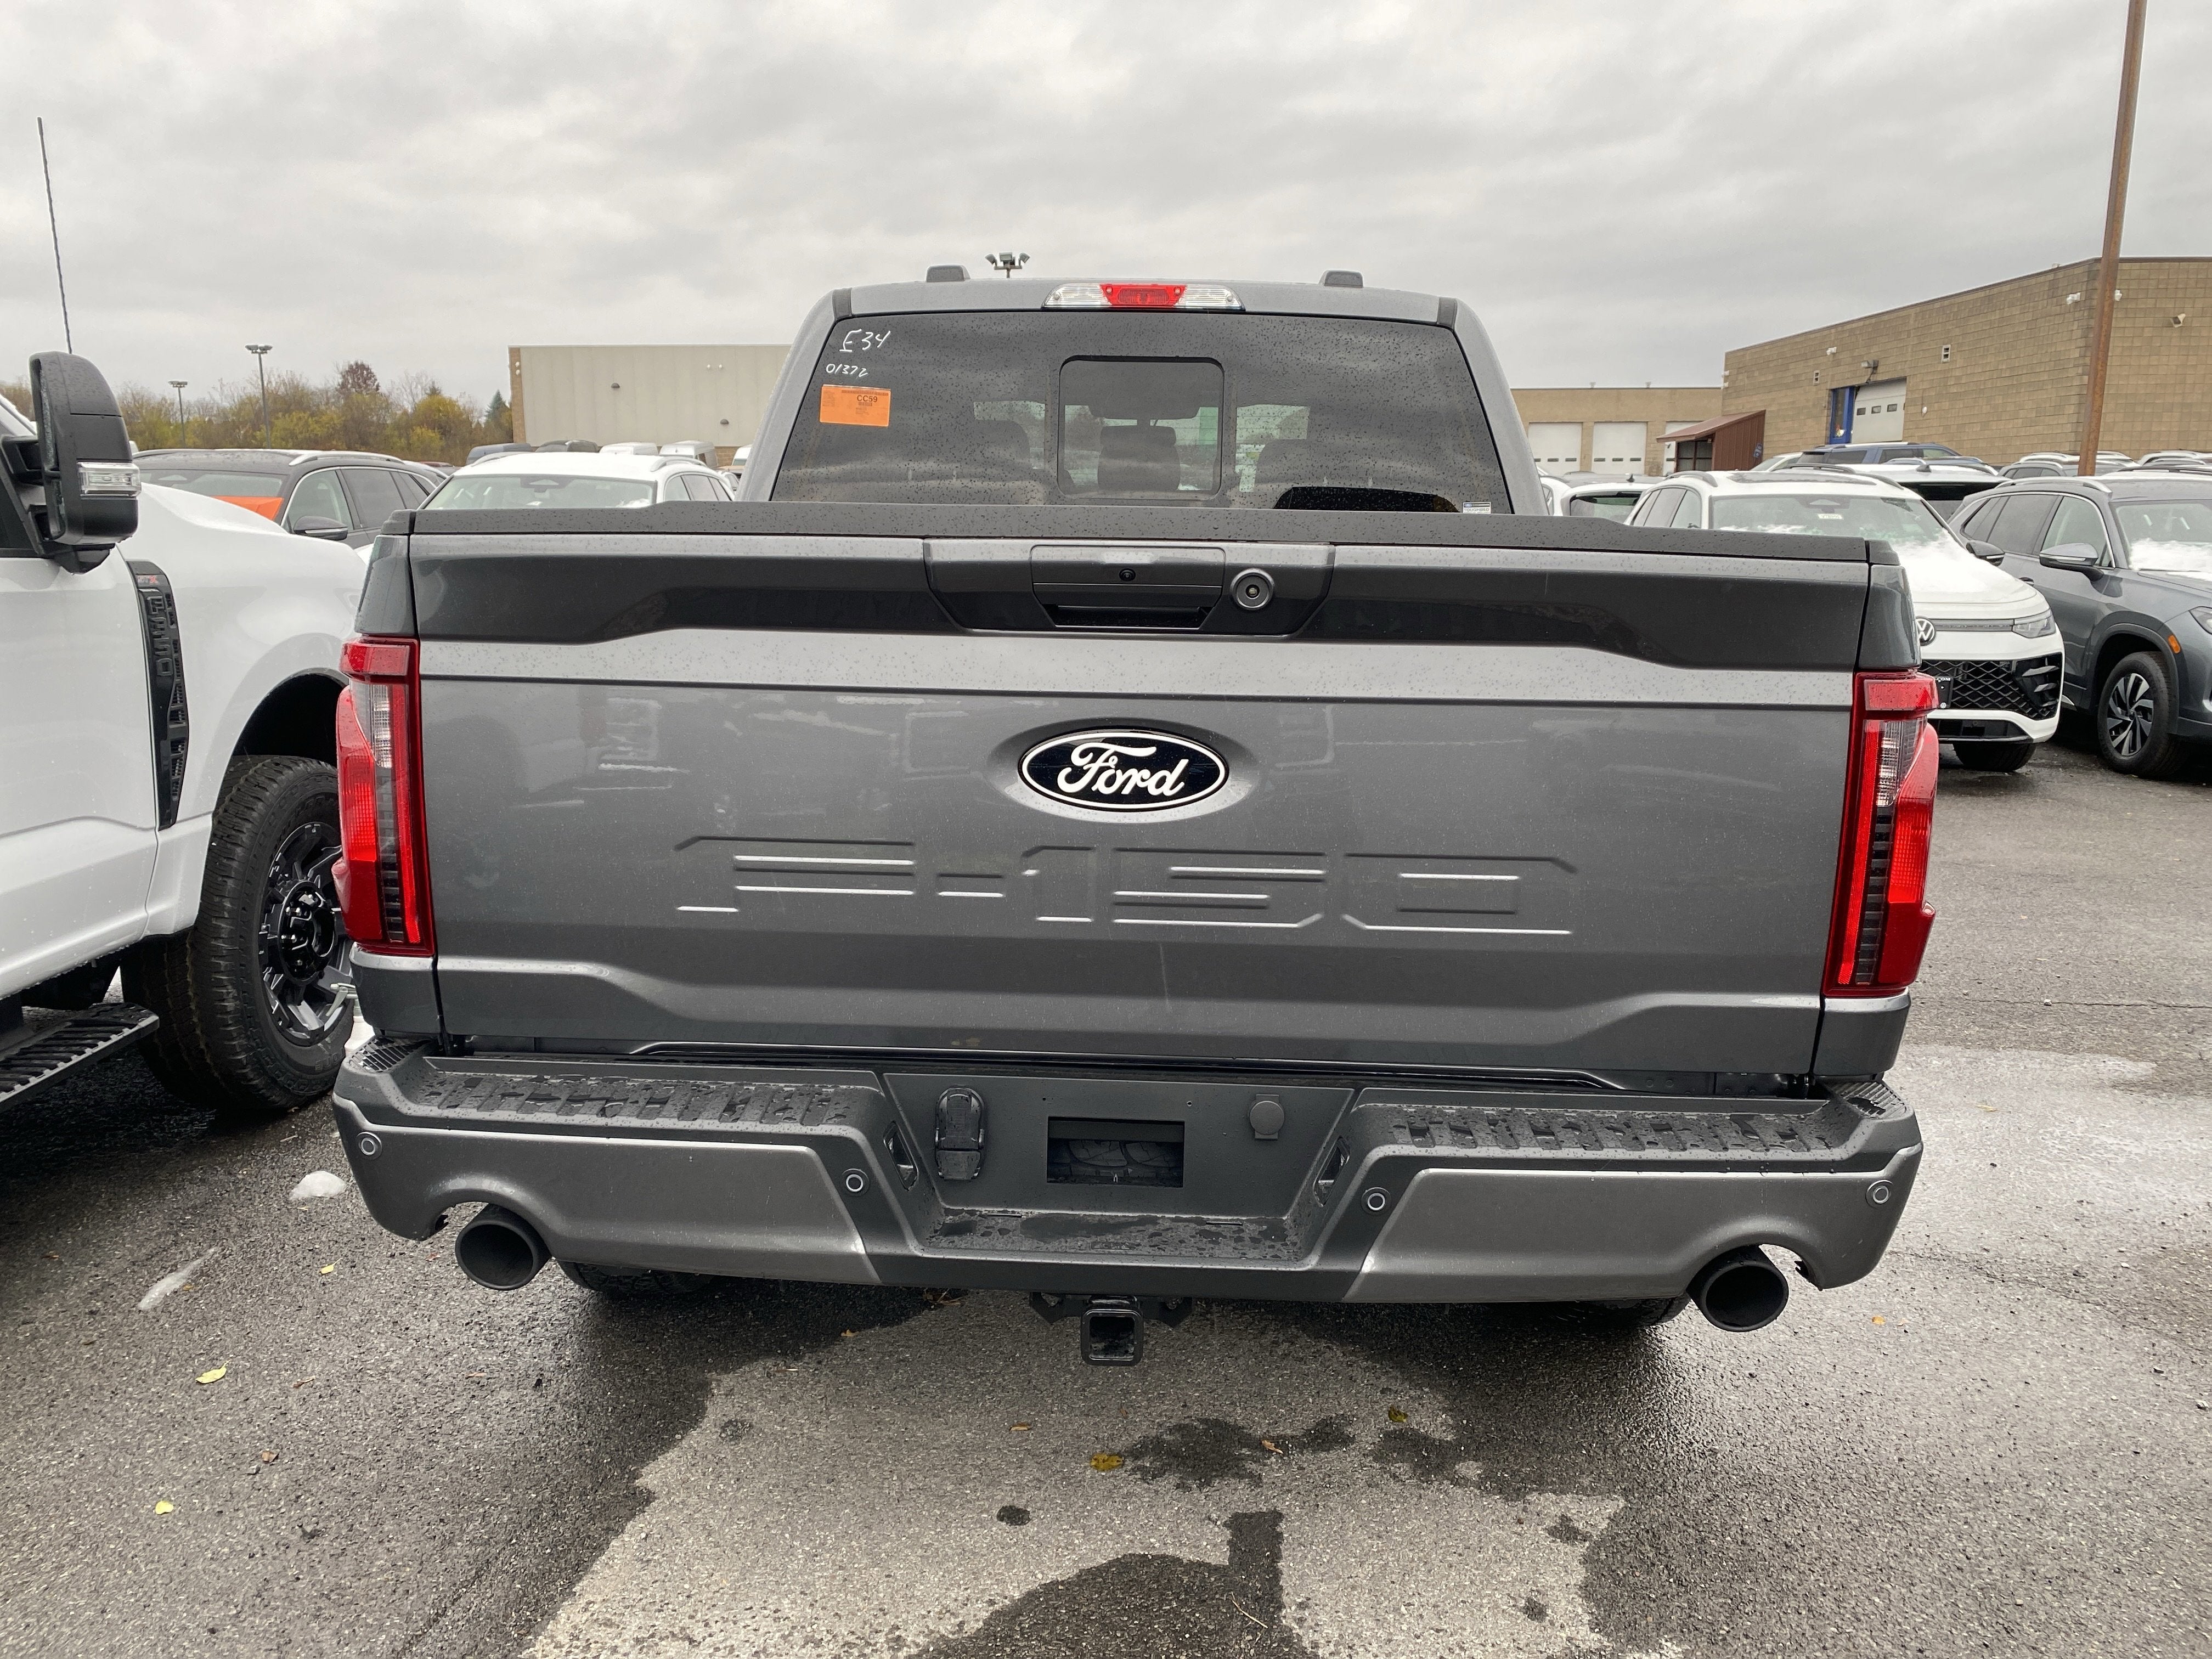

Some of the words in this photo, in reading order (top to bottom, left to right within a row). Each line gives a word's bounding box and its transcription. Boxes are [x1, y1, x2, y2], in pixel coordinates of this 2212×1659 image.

[839, 329, 891, 352] E34
[826, 363, 868, 377] 01372
[856, 394, 878, 403] CC59
[1057, 742, 1189, 797] Ford
[675, 836, 1577, 935] F-150
